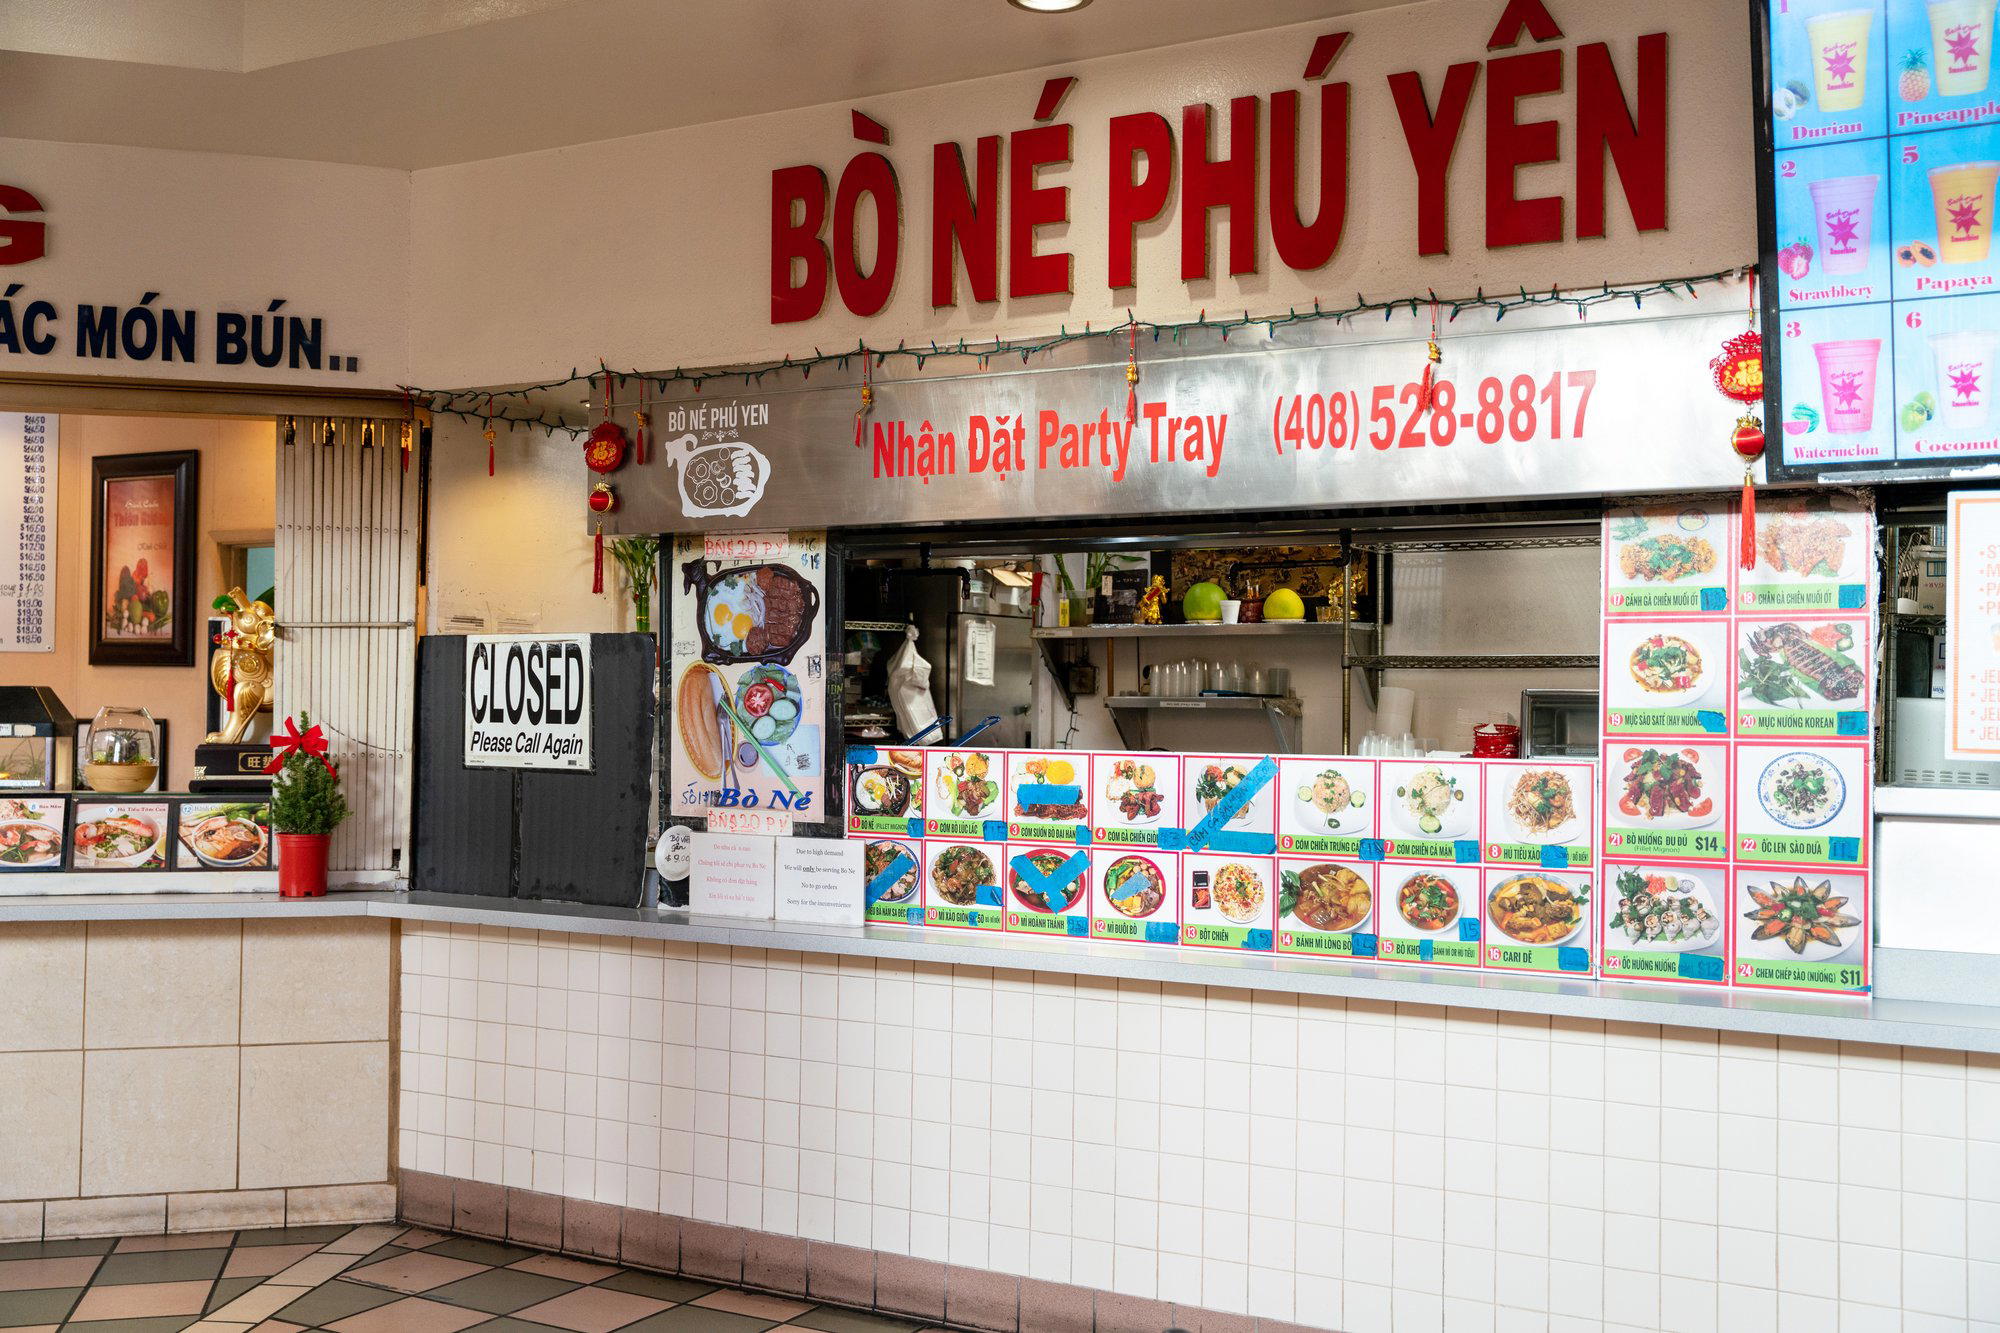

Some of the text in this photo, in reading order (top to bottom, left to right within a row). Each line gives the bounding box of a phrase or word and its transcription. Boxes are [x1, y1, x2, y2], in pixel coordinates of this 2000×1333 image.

[1792, 121, 1863, 141] Durian
[771, 0, 1669, 325] BÒ NÉ PHÚ YÊN
[1902, 145, 1919, 165] 5
[1781, 160, 1797, 178] 2
[1916, 275, 1993, 292] Papaya
[76, 292, 196, 364] MÓN
[1905, 311, 1922, 329] 6
[1785, 321, 1802, 338] 3
[668, 400, 769, 433] BÒ NÉ PHÚ YEN
[1273, 369, 1598, 454] (408) 528-8817
[872, 402, 1229, 485] Nhận Đặt Party Tray
[1793, 443, 1880, 461] Watermelon
[1915, 437, 1999, 454] Coconut
[470, 641, 584, 726] CLOSED
[1804, 716, 1834, 728] KOREAN
[470, 731, 583, 759] Please Call Again
[720, 788, 759, 808] Bò
[767, 790, 813, 811] Né
[1626, 832, 1636, 845] BÒ
[1695, 836, 1718, 851] $14
[1773, 842, 1787, 853] LEN
[1789, 840, 1805, 854] SÀO
[813, 849, 824, 857] high
[802, 866, 816, 874] only
[822, 867, 840, 875] serving
[786, 898, 800, 906] Sorry
[1296, 934, 1314, 947] BÁNH
[1324, 936, 1341, 949] LÒNG
[1396, 941, 1406, 954] BÒ
[1406, 944, 1421, 955] KHO
[1503, 951, 1521, 962] CARI
[1755, 968, 1774, 979] CHEM
[1775, 966, 1791, 980] CHÉP
[1793, 967, 1806, 981] SÀO
[1840, 968, 1861, 986] $11
